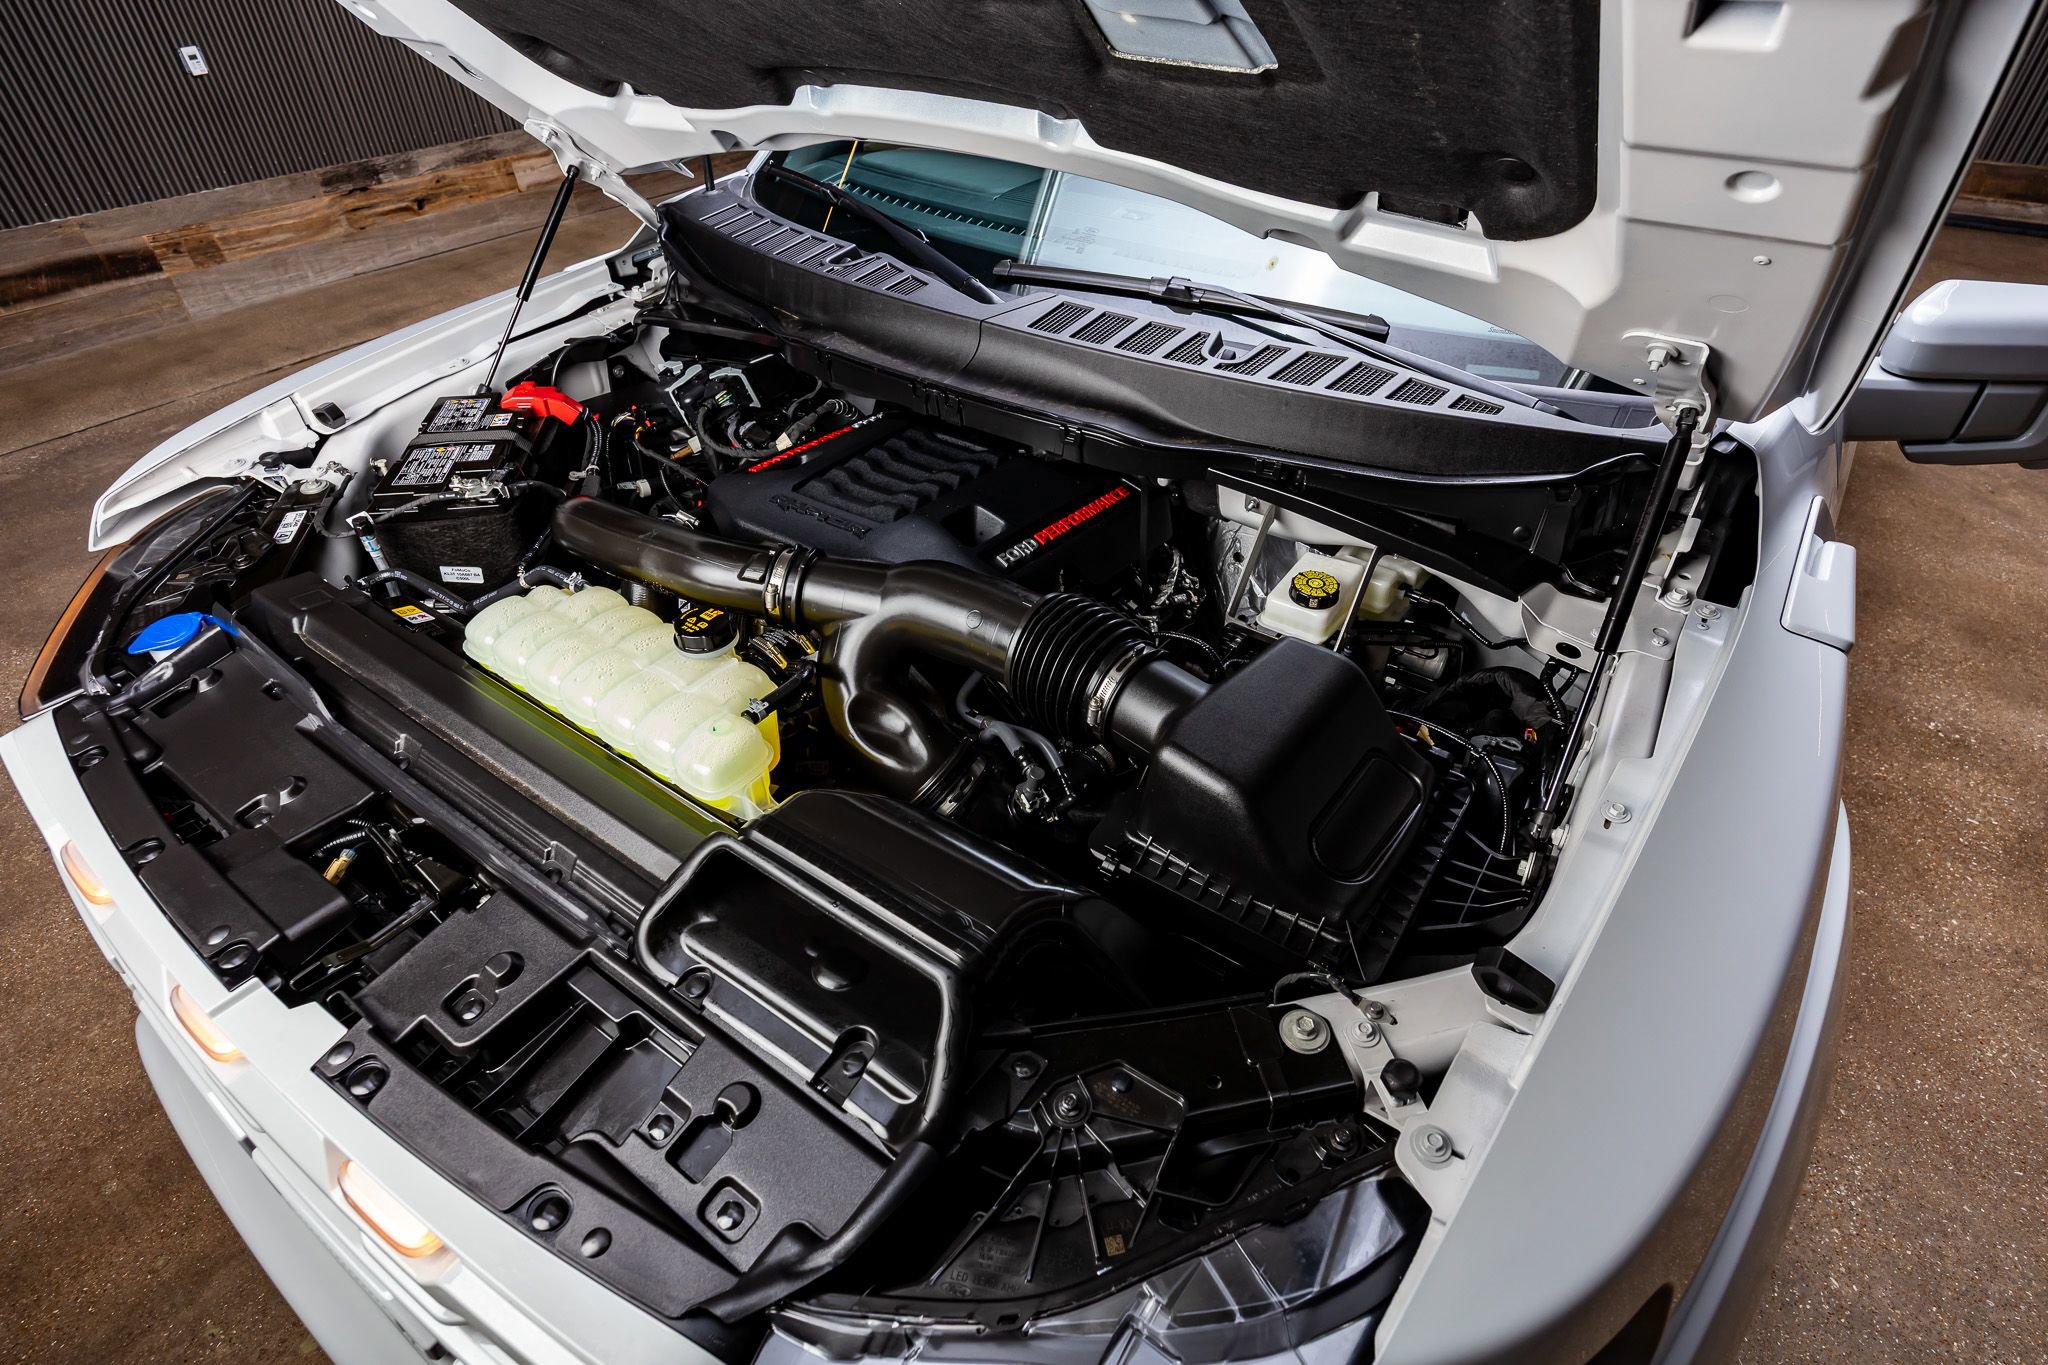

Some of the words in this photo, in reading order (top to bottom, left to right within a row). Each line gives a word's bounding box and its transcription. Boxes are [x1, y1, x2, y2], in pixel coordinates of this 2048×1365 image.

[996, 538, 1039, 568] FORD
[1033, 486, 1131, 546] PERFORMANCE
[950, 1270, 969, 1283] LED
